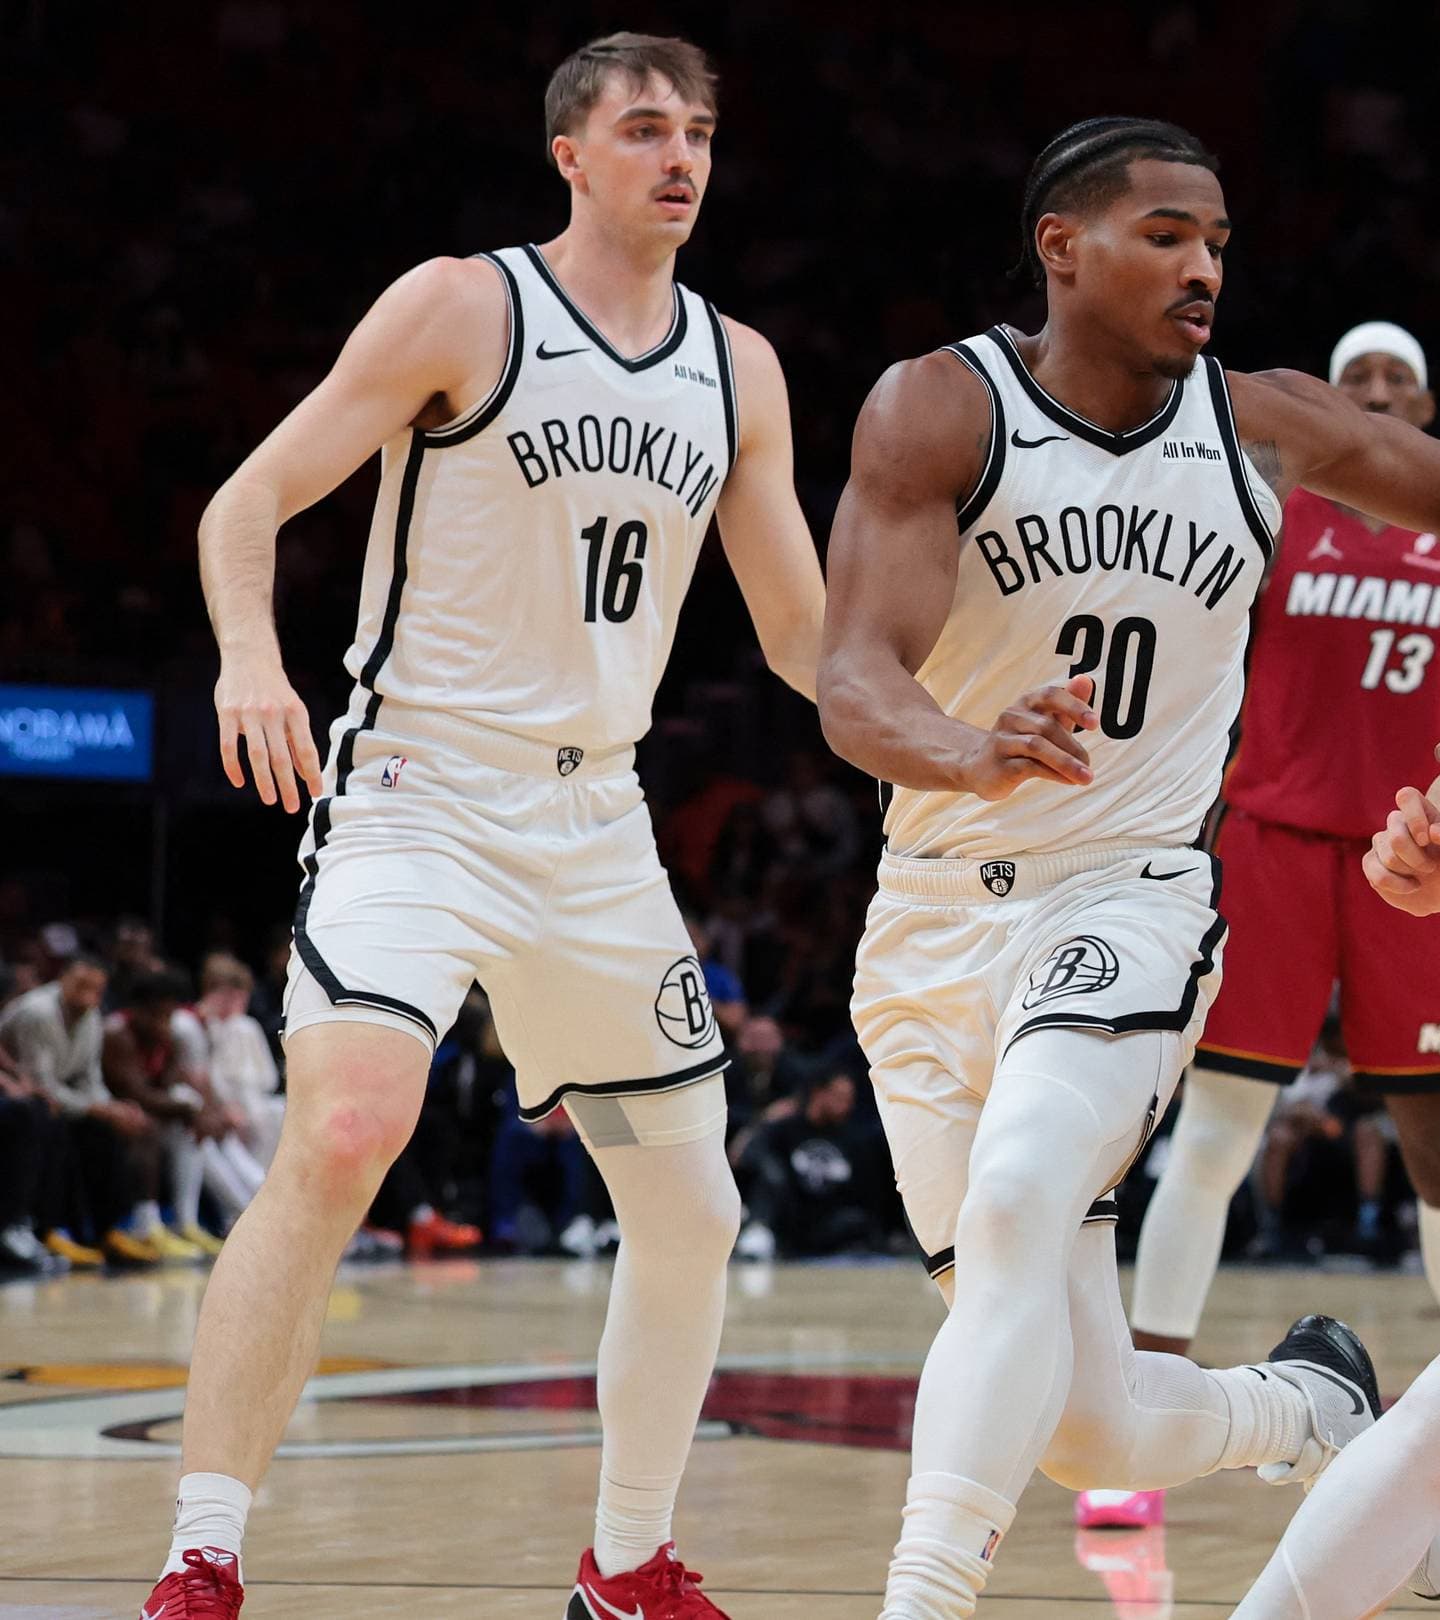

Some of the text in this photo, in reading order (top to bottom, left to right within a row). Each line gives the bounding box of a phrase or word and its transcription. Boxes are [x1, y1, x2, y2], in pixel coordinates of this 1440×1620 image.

[506, 414, 719, 518] BROOKLYN
[1162, 441, 1222, 461] All In Won
[580, 516, 648, 624] 16
[975, 504, 1246, 611] BROOKLYN
[1360, 628, 1435, 694] 13
[559, 749, 582, 763] NETS
[982, 863, 1014, 881] NETS
[680, 971, 707, 1036] B
[1040, 946, 1087, 997] B
